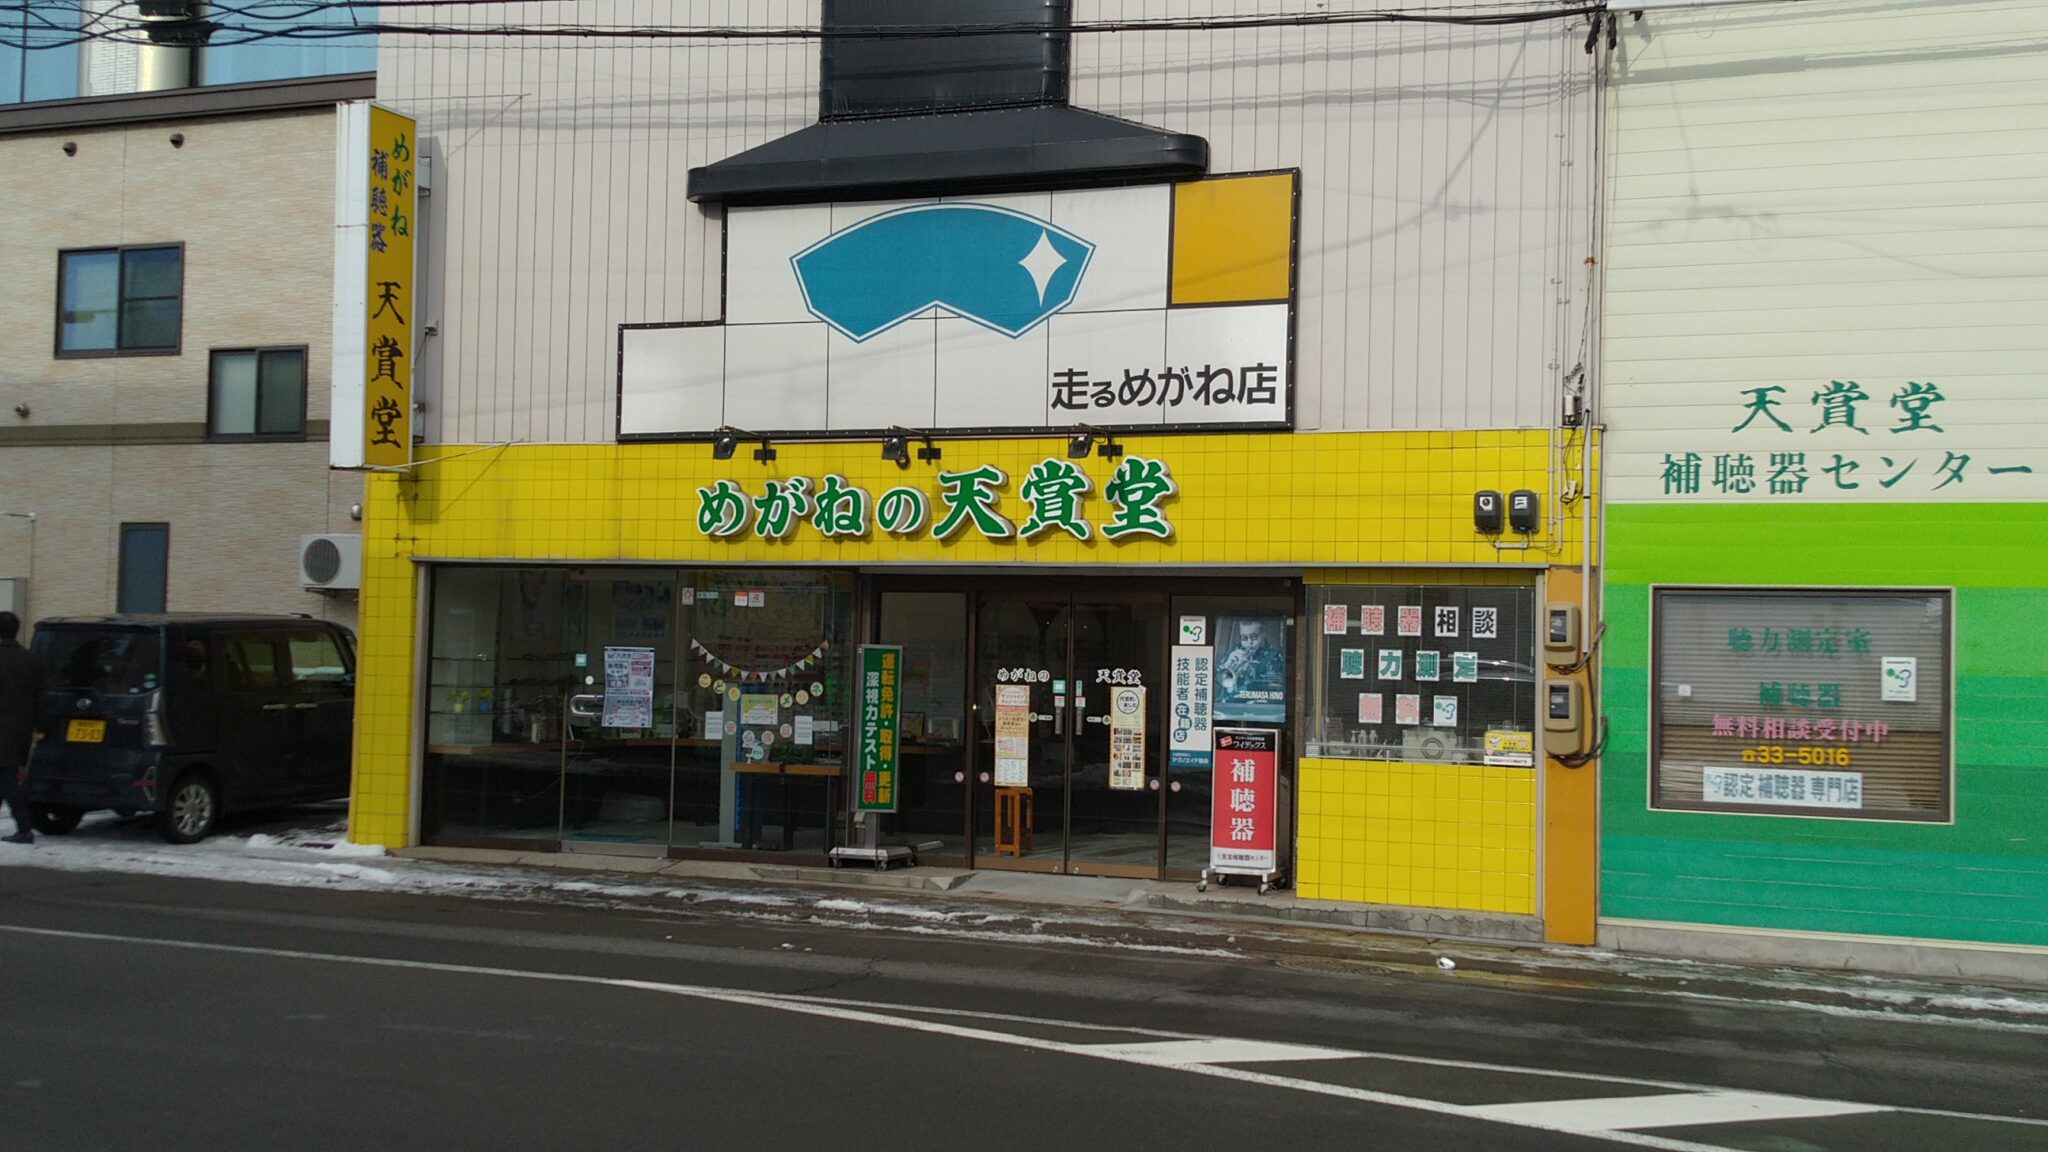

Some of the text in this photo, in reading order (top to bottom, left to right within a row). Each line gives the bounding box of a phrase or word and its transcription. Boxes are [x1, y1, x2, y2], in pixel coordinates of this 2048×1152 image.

[370, 148, 389, 254] 補聴器
[390, 133, 410, 238] めがね
[371, 281, 406, 449] 天賞堂
[1050, 362, 1278, 410] 走るめがね店
[1732, 379, 1946, 436] 天賞堂
[1659, 450, 2033, 495] 補聴器センター
[696, 456, 1176, 541] めがねの天賞堂
[1326, 606, 1496, 635] 補聴器相談
[1728, 626, 1872, 655] 聴力測定室
[997, 668, 1141, 685] めがねの 天賞堂
[1342, 651, 1477, 680] 聴力測定
[1194, 657, 1209, 731] 認定補聴器
[1760, 678, 1840, 708] 補聴器
[1712, 714, 1889, 742] 無料相談受付中
[1758, 745, 1850, 766] 33-5016
[1230, 758, 1256, 842] 補聴器
